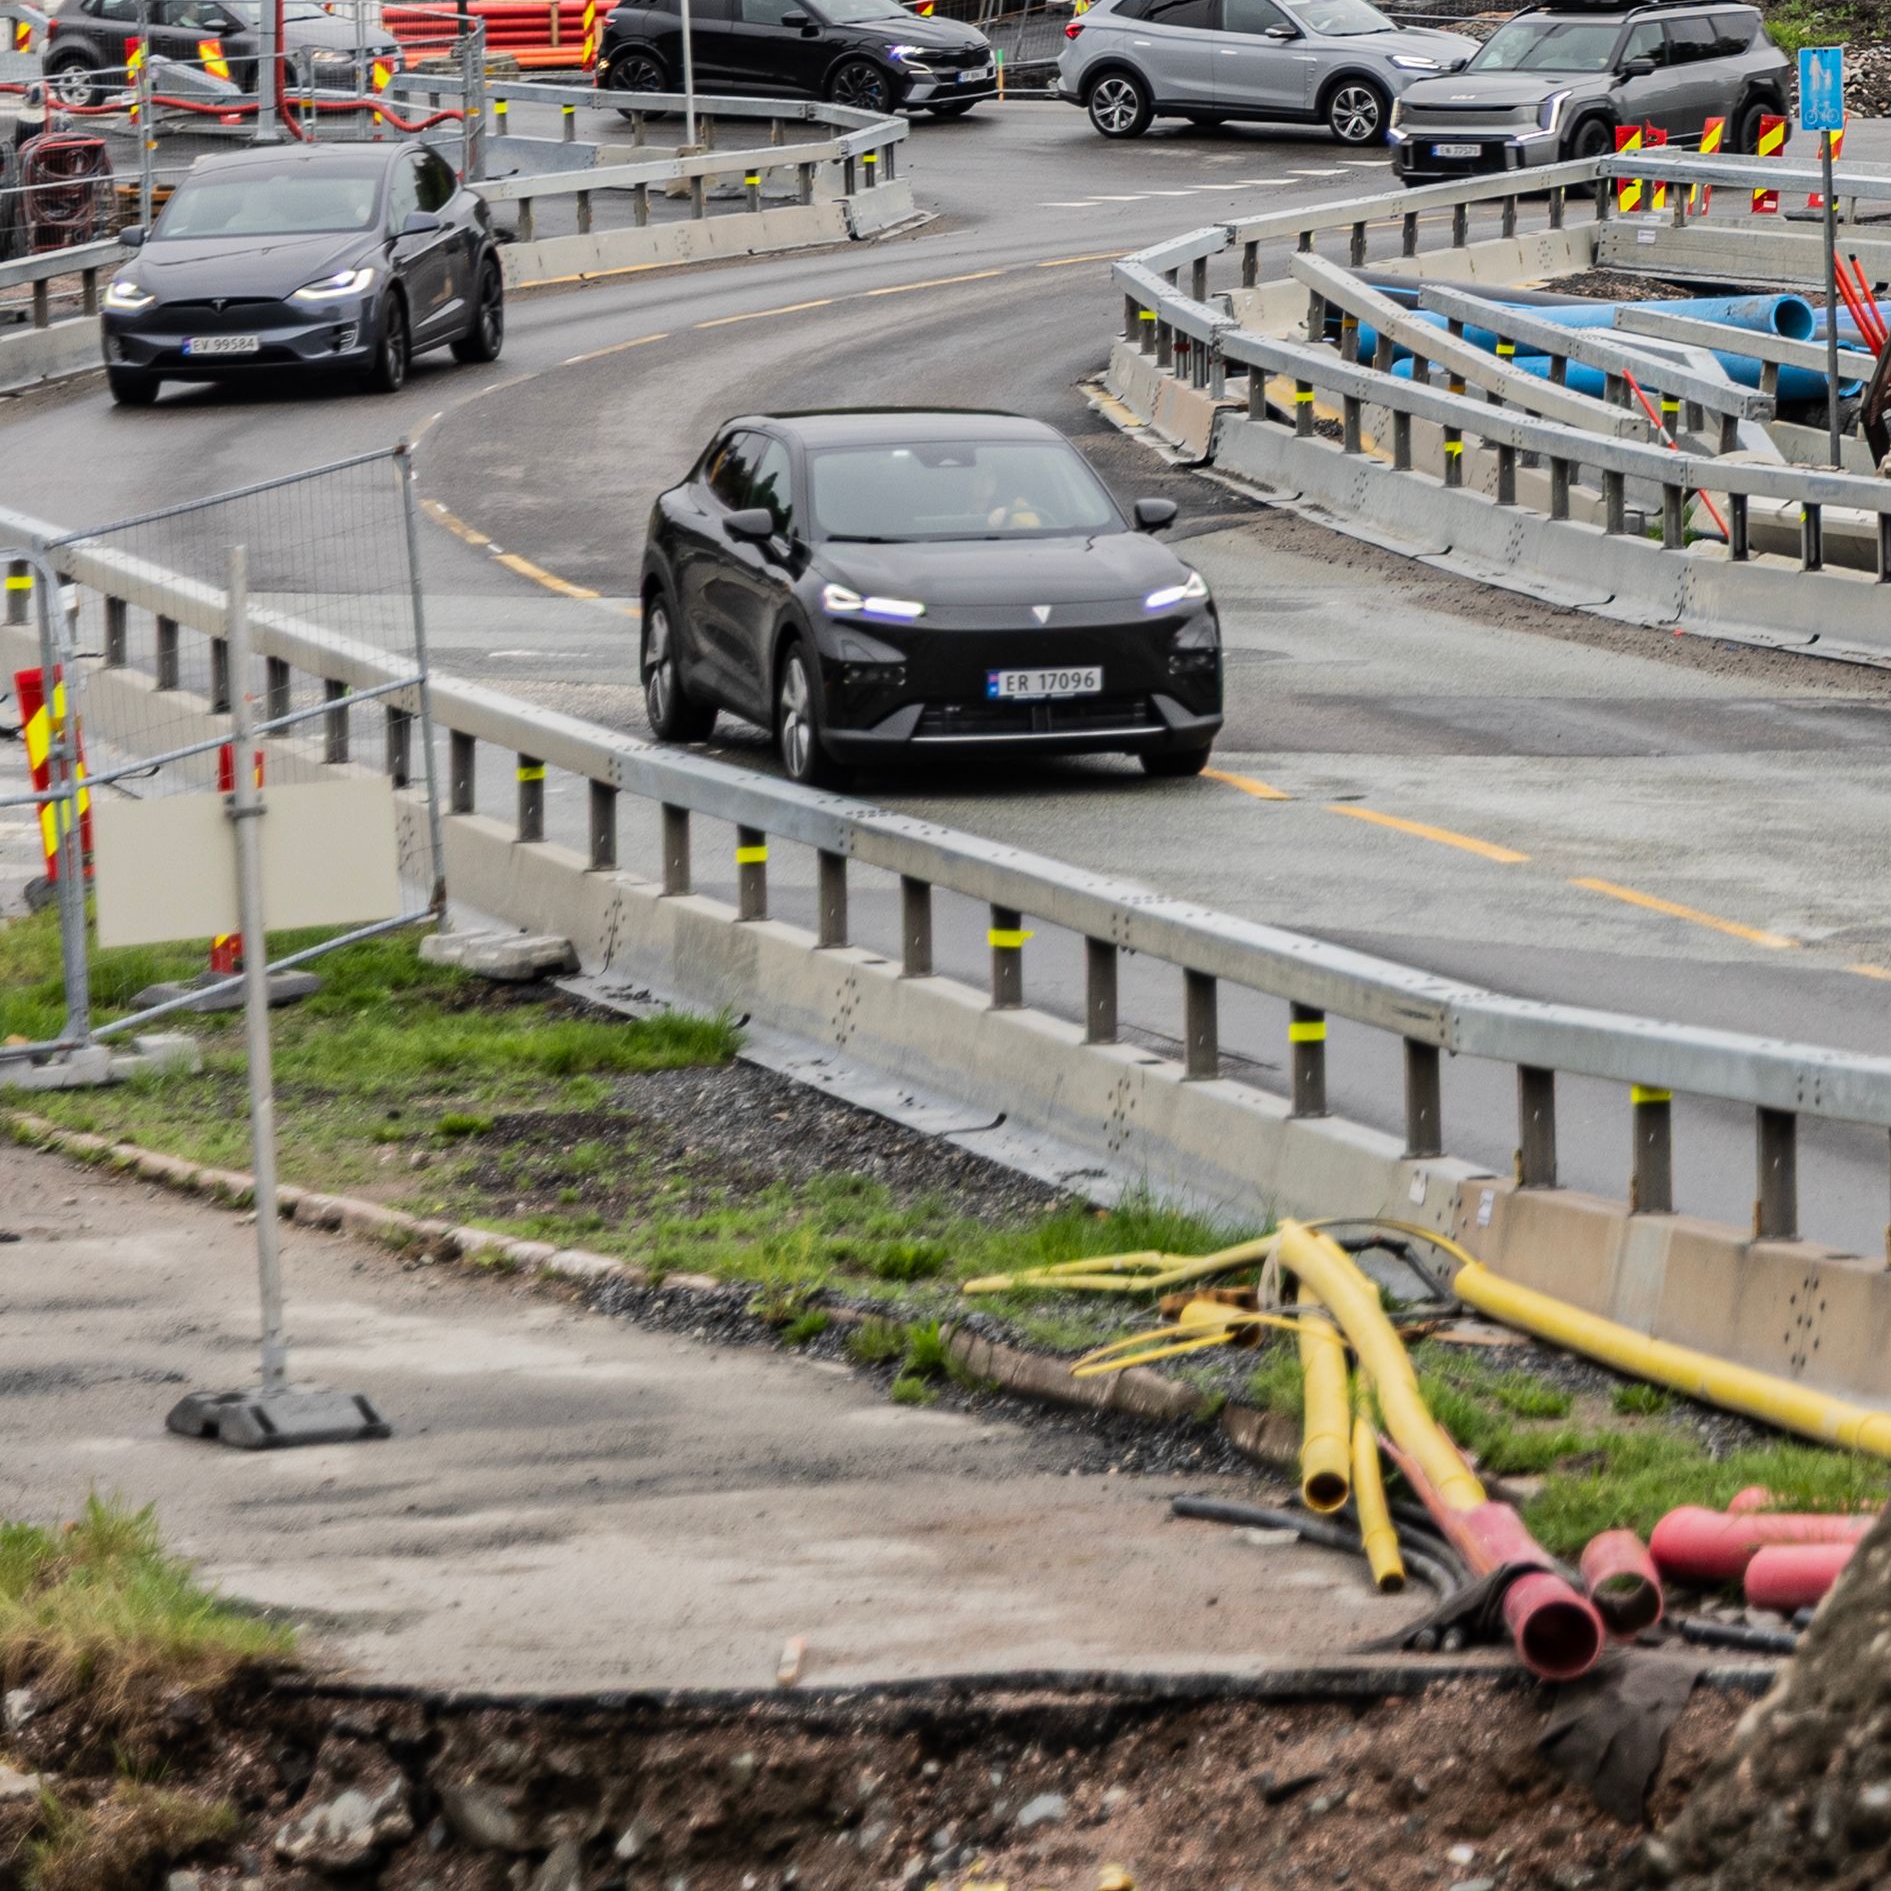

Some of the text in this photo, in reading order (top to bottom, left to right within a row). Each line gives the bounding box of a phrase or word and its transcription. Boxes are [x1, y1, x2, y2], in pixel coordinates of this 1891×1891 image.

[193, 339, 208, 351] EV
[1006, 671, 1095, 692] ER 17096
